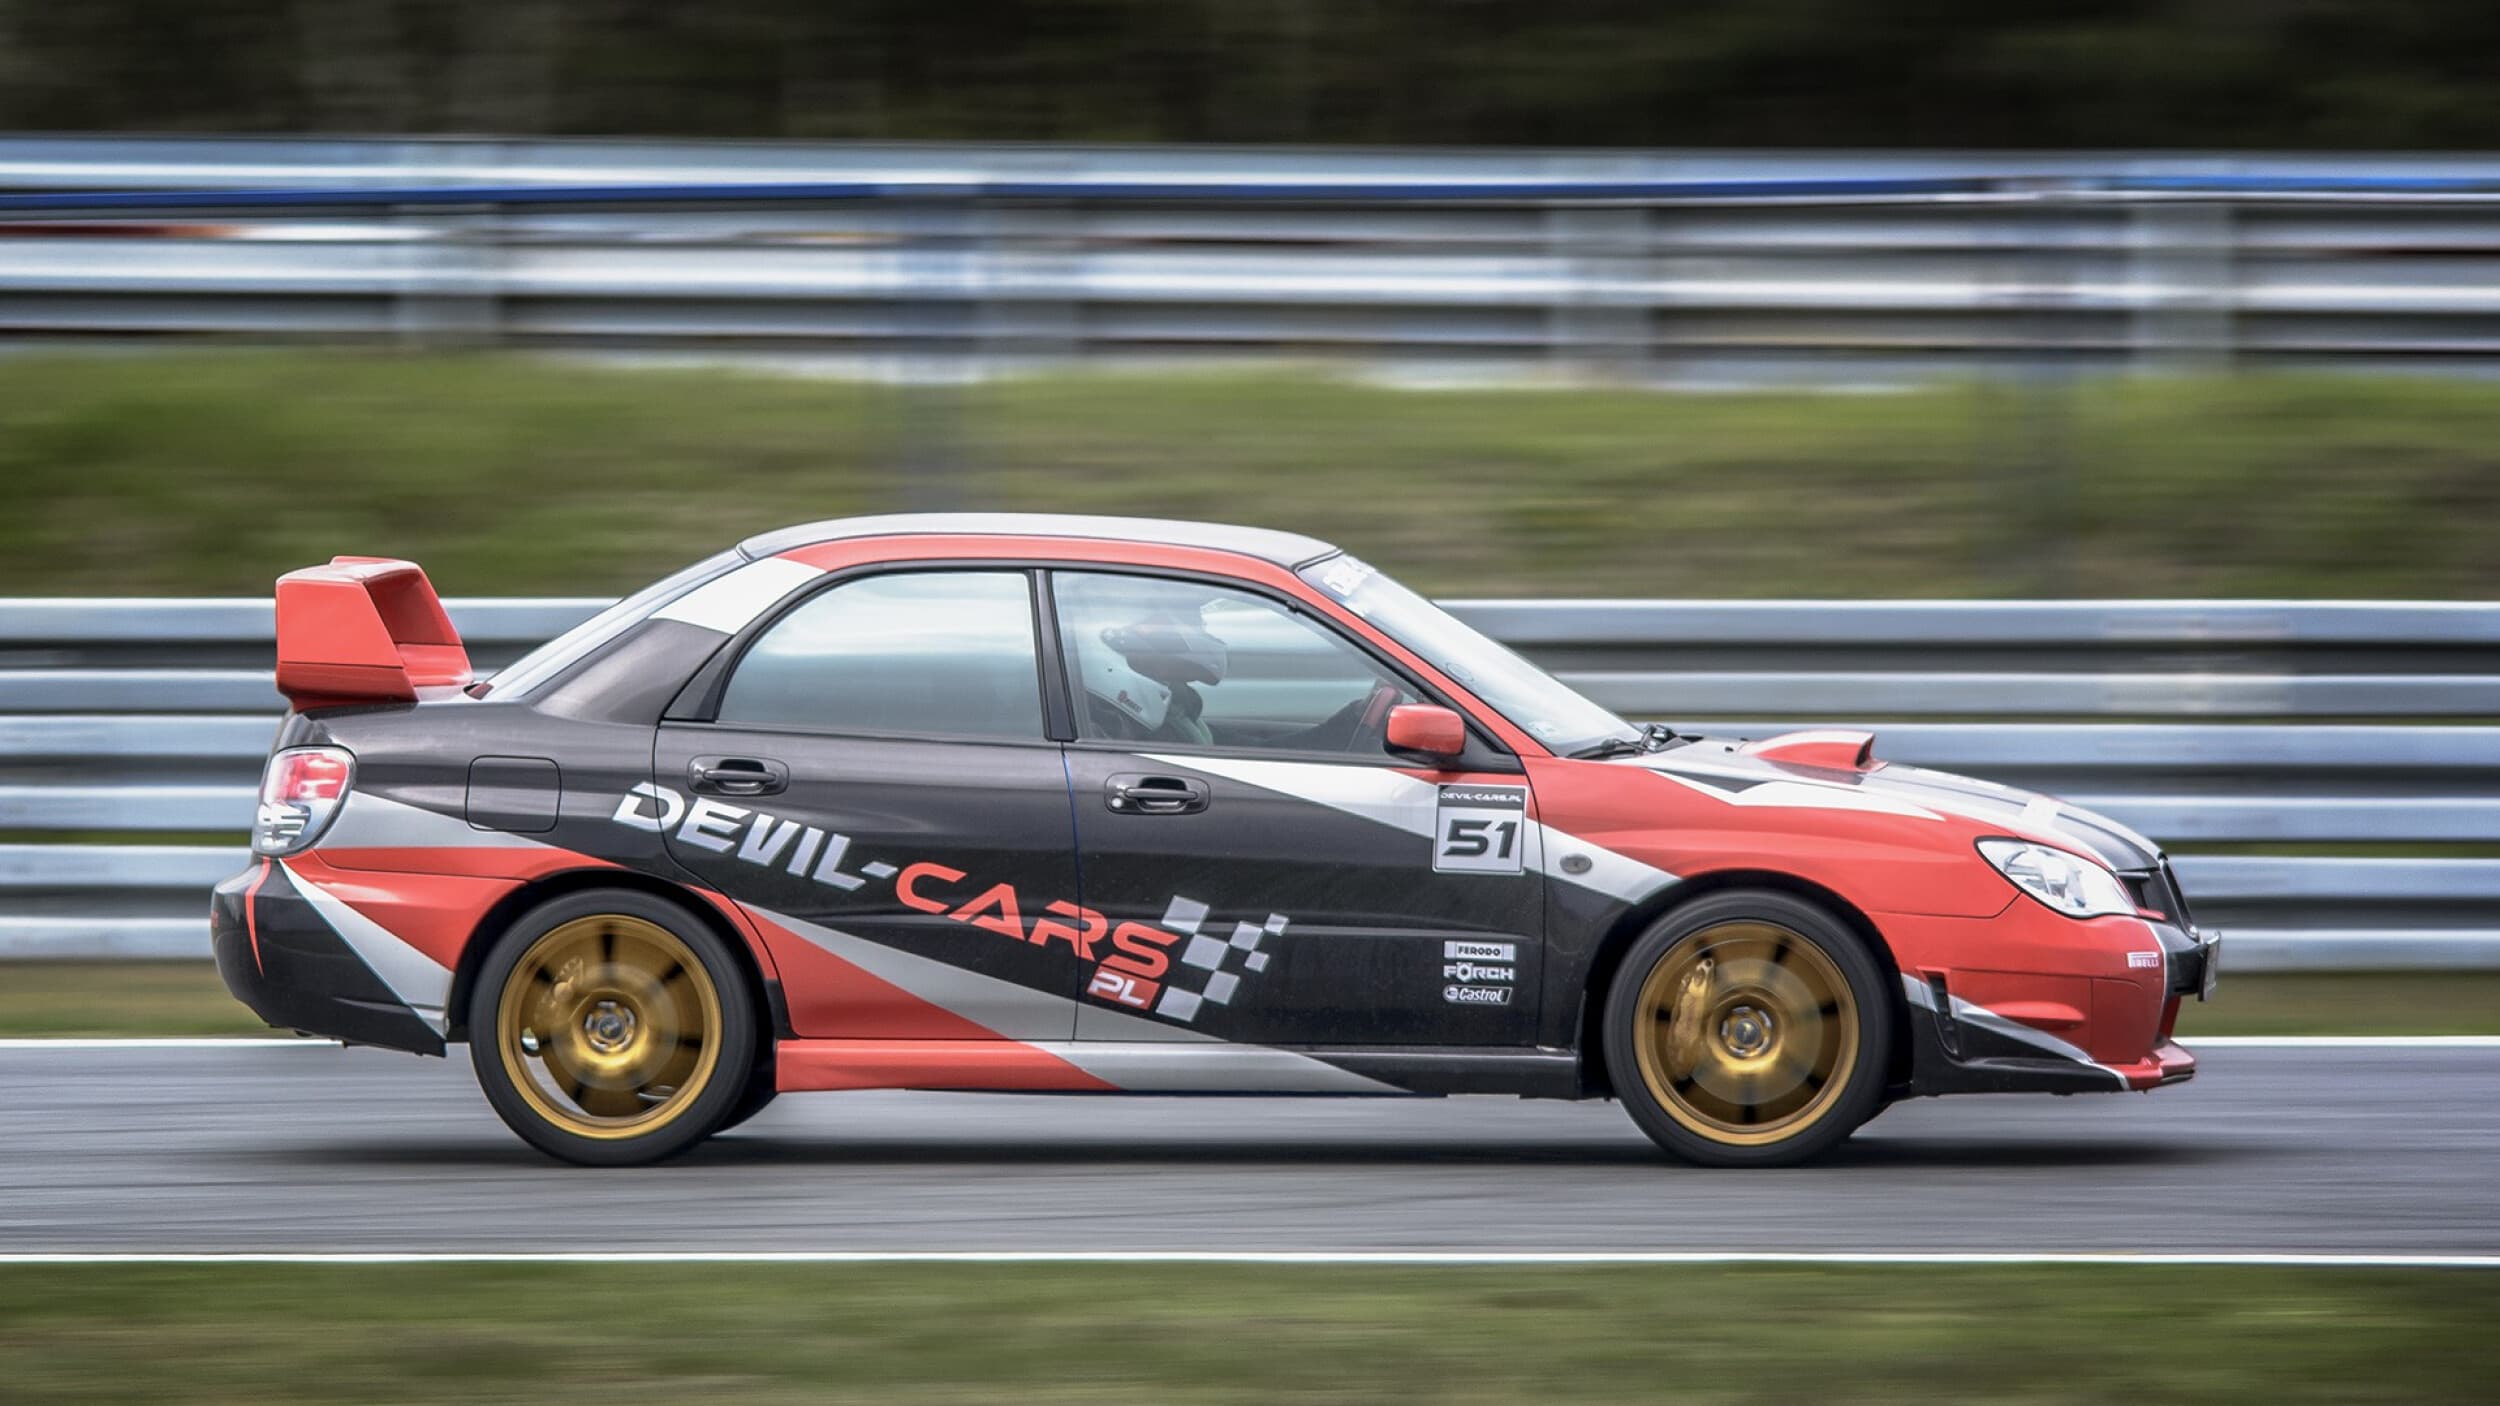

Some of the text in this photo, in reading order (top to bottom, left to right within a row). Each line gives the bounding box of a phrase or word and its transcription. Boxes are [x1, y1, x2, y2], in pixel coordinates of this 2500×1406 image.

[1443, 820, 1518, 858] 51
[612, 781, 1180, 979] DEVIL-CARS
[1458, 946, 1501, 957] FERODO
[1091, 970, 1145, 1006] PL
[1459, 988, 1503, 1002] Castrol
